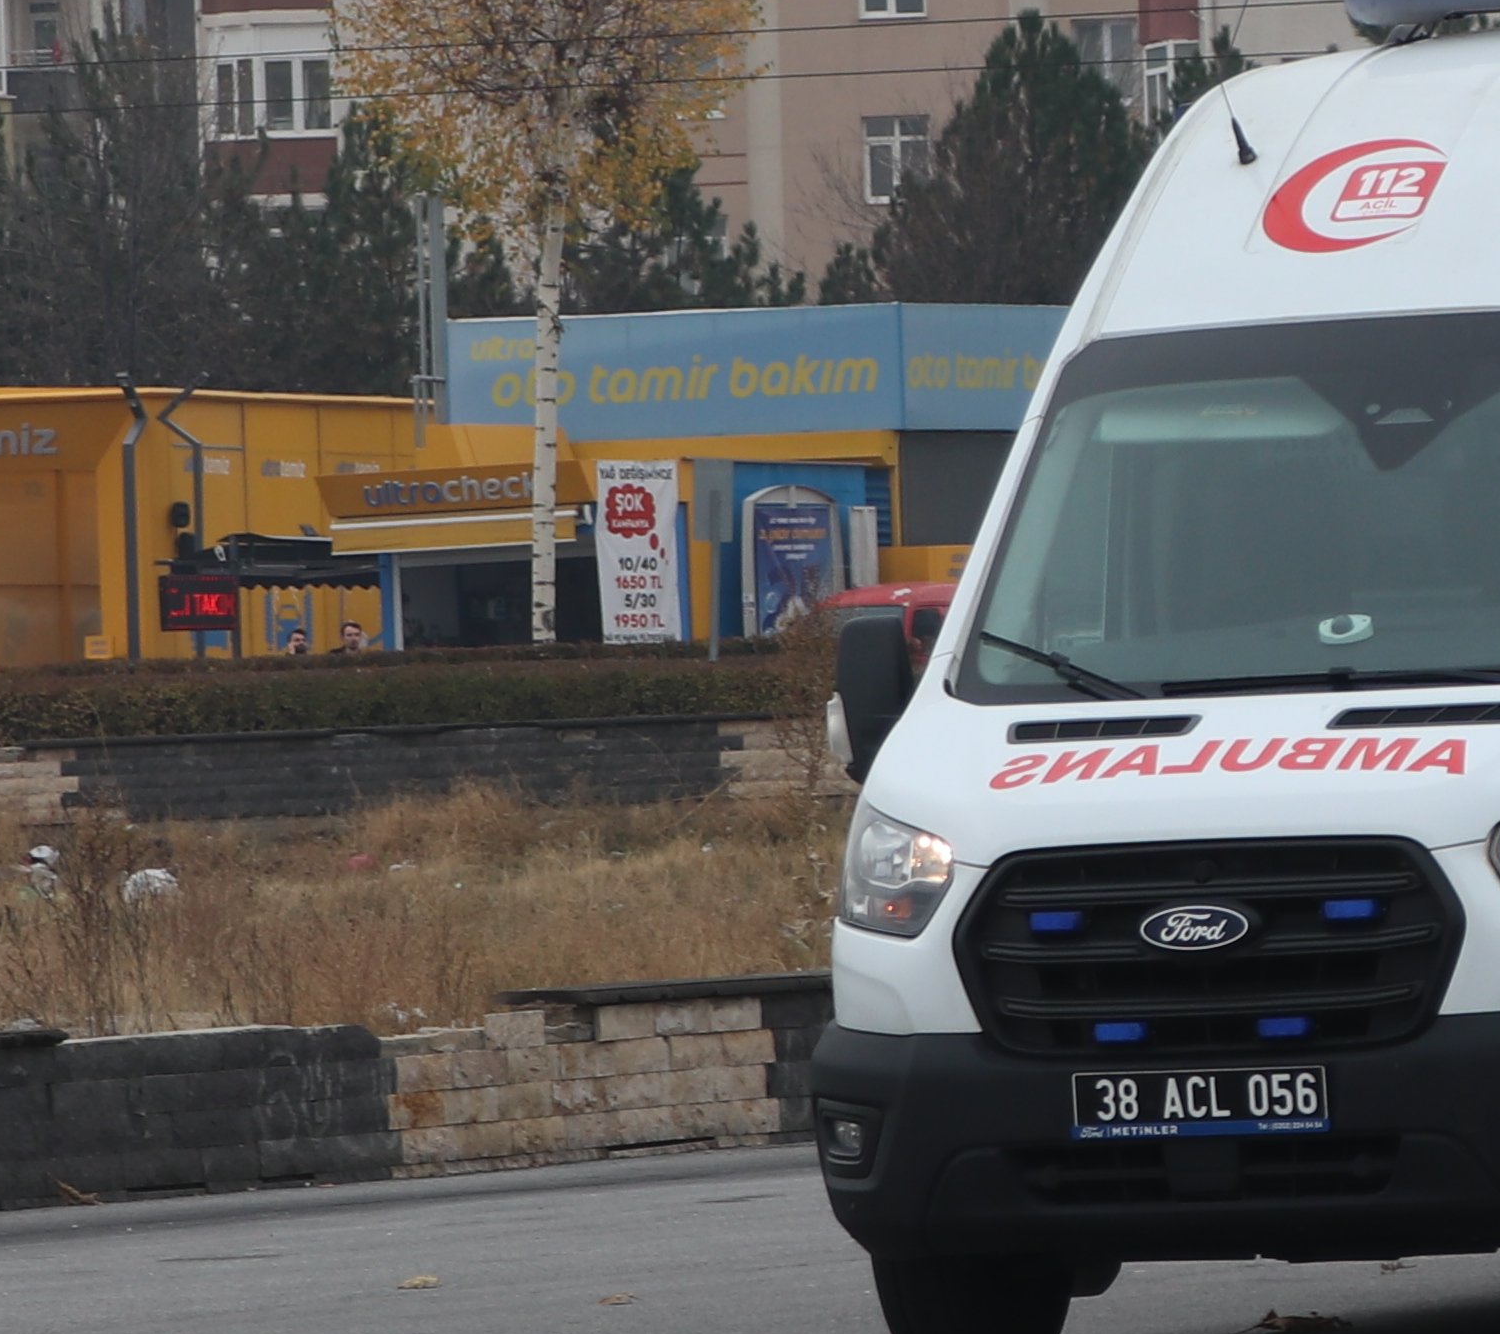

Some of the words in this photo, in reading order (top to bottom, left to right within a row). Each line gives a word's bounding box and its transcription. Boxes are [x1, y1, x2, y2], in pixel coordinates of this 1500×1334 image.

[1357, 167, 1426, 197] 112
[471, 334, 534, 363] ultra
[588, 354, 718, 404] tamir
[729, 354, 879, 399] bakım
[615, 493, 645, 516] ŞOK
[618, 556, 658, 573] 10/40
[615, 575, 647, 589] 1650
[650, 575, 663, 589] TL
[624, 594, 656, 610] 5/30
[614, 614, 648, 628] 1950
[651, 614, 665, 627] TL
[1158, 911, 1227, 945] Ford
[1095, 1078, 1139, 1122] 38
[1163, 1075, 1232, 1119] ACL
[1248, 1072, 1318, 1117] 056
